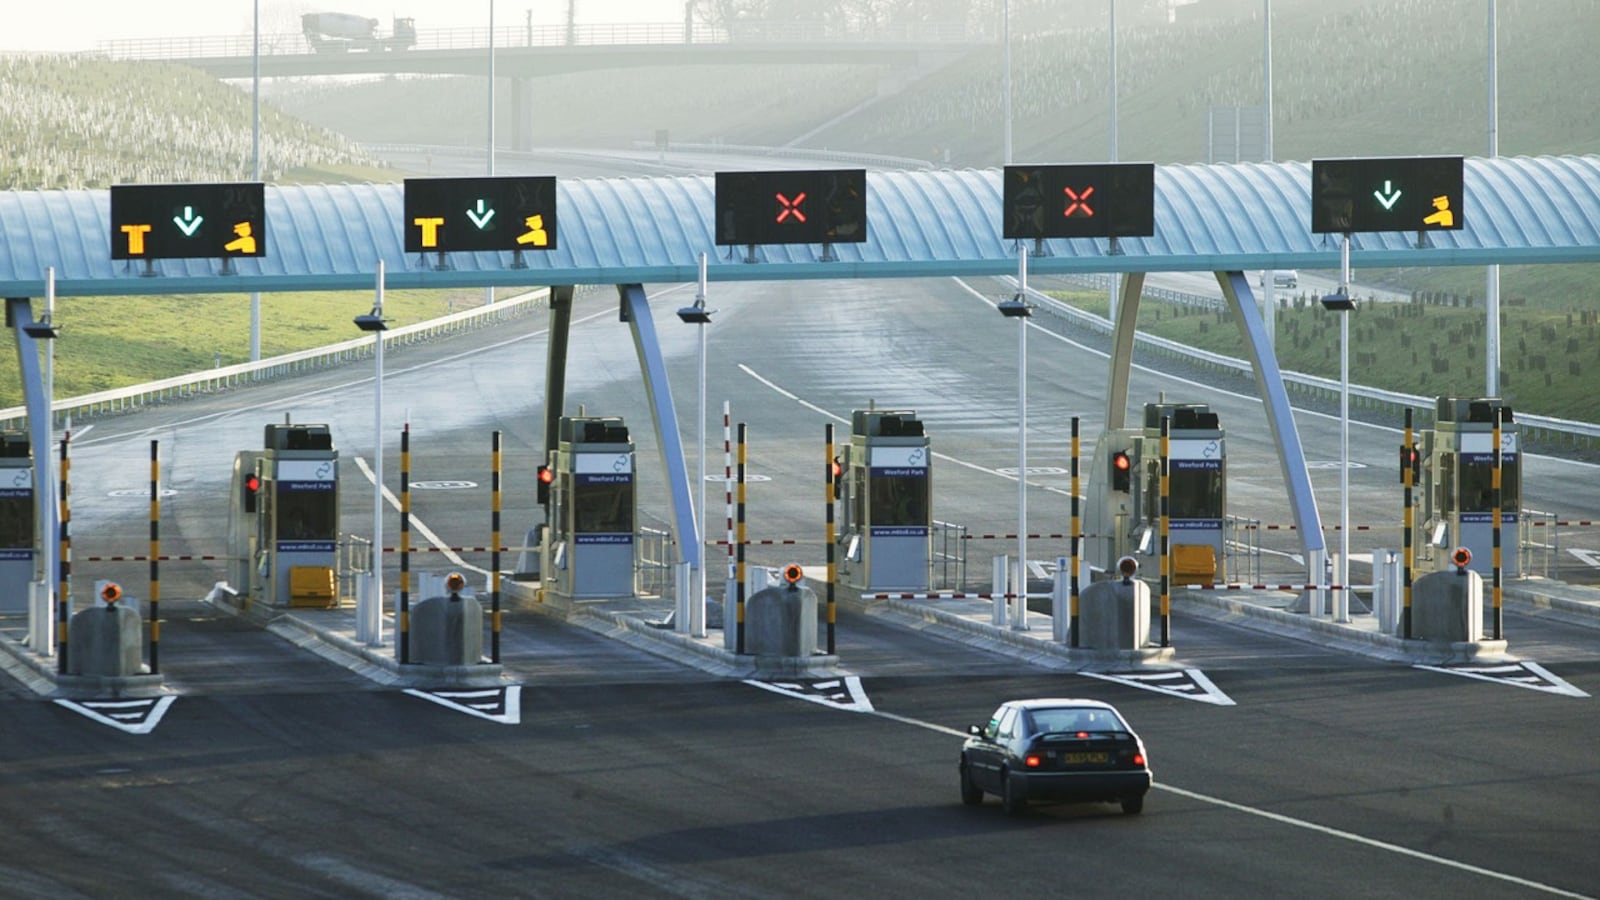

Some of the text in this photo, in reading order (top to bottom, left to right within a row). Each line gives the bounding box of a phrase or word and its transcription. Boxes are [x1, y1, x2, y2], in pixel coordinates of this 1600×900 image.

[120, 224, 151, 254] T
[413, 217, 444, 247] T
[911, 468, 924, 476] Park
[1205, 461, 1219, 469] Park
